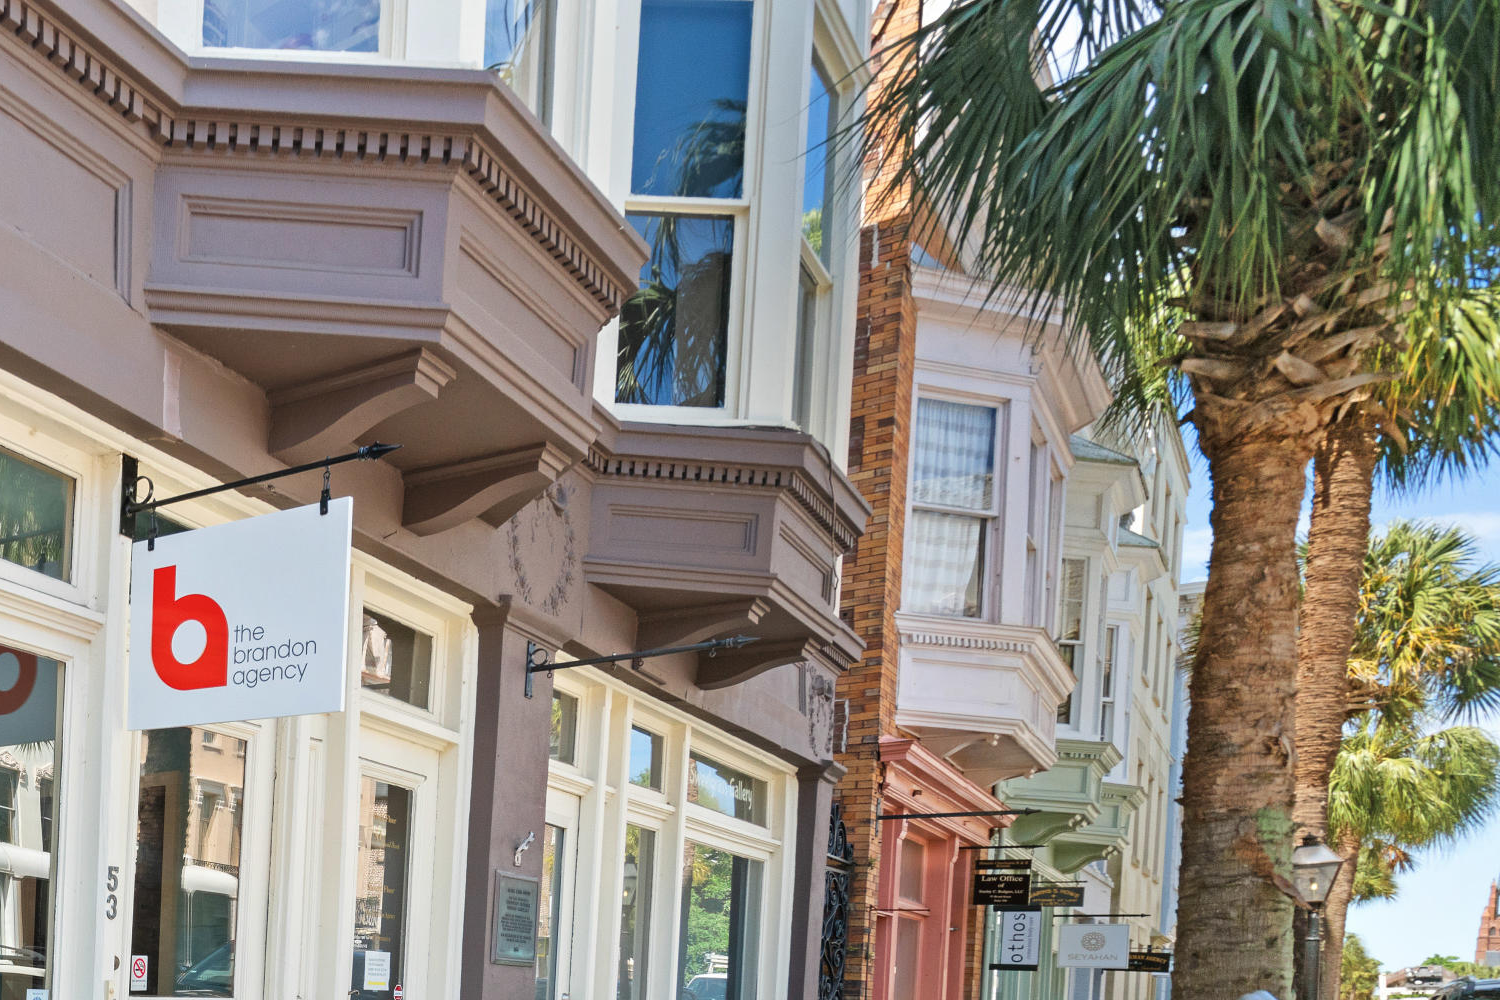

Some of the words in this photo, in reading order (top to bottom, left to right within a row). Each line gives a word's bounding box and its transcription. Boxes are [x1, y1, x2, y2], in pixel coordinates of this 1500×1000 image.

[234, 624, 265, 643] the
[233, 638, 317, 664] brandon
[232, 662, 308, 688] agency
[729, 777, 753, 811] Gallery
[106, 865, 120, 920] 53
[1008, 913, 1026, 963] othos
[1067, 953, 1118, 961] SEYAHAN
